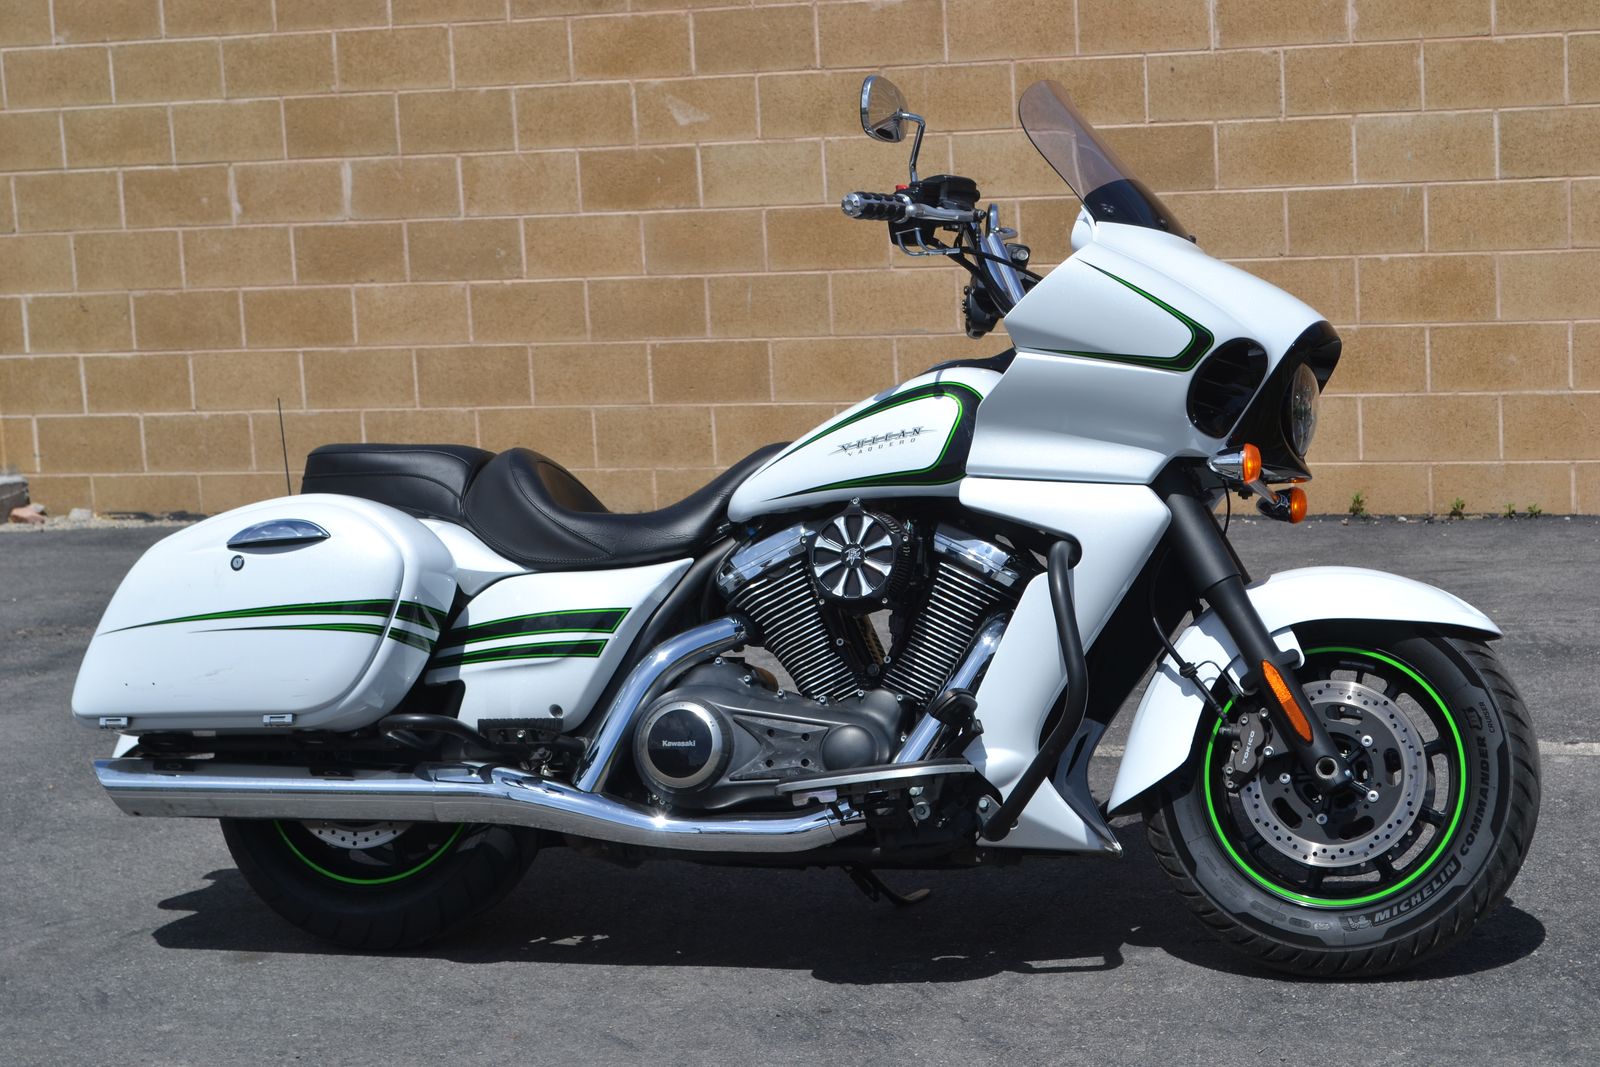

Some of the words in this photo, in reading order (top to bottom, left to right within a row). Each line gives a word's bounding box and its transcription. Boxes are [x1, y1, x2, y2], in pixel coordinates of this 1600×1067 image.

[837, 426, 924, 452] VULCAN
[847, 438, 916, 457] VAQUERO
[1479, 701, 1495, 734] CRUISER
[1242, 730, 1255, 765] TOKICO
[1374, 862, 1458, 922] MICHELIN
[1460, 735, 1489, 856] COMMANDER
